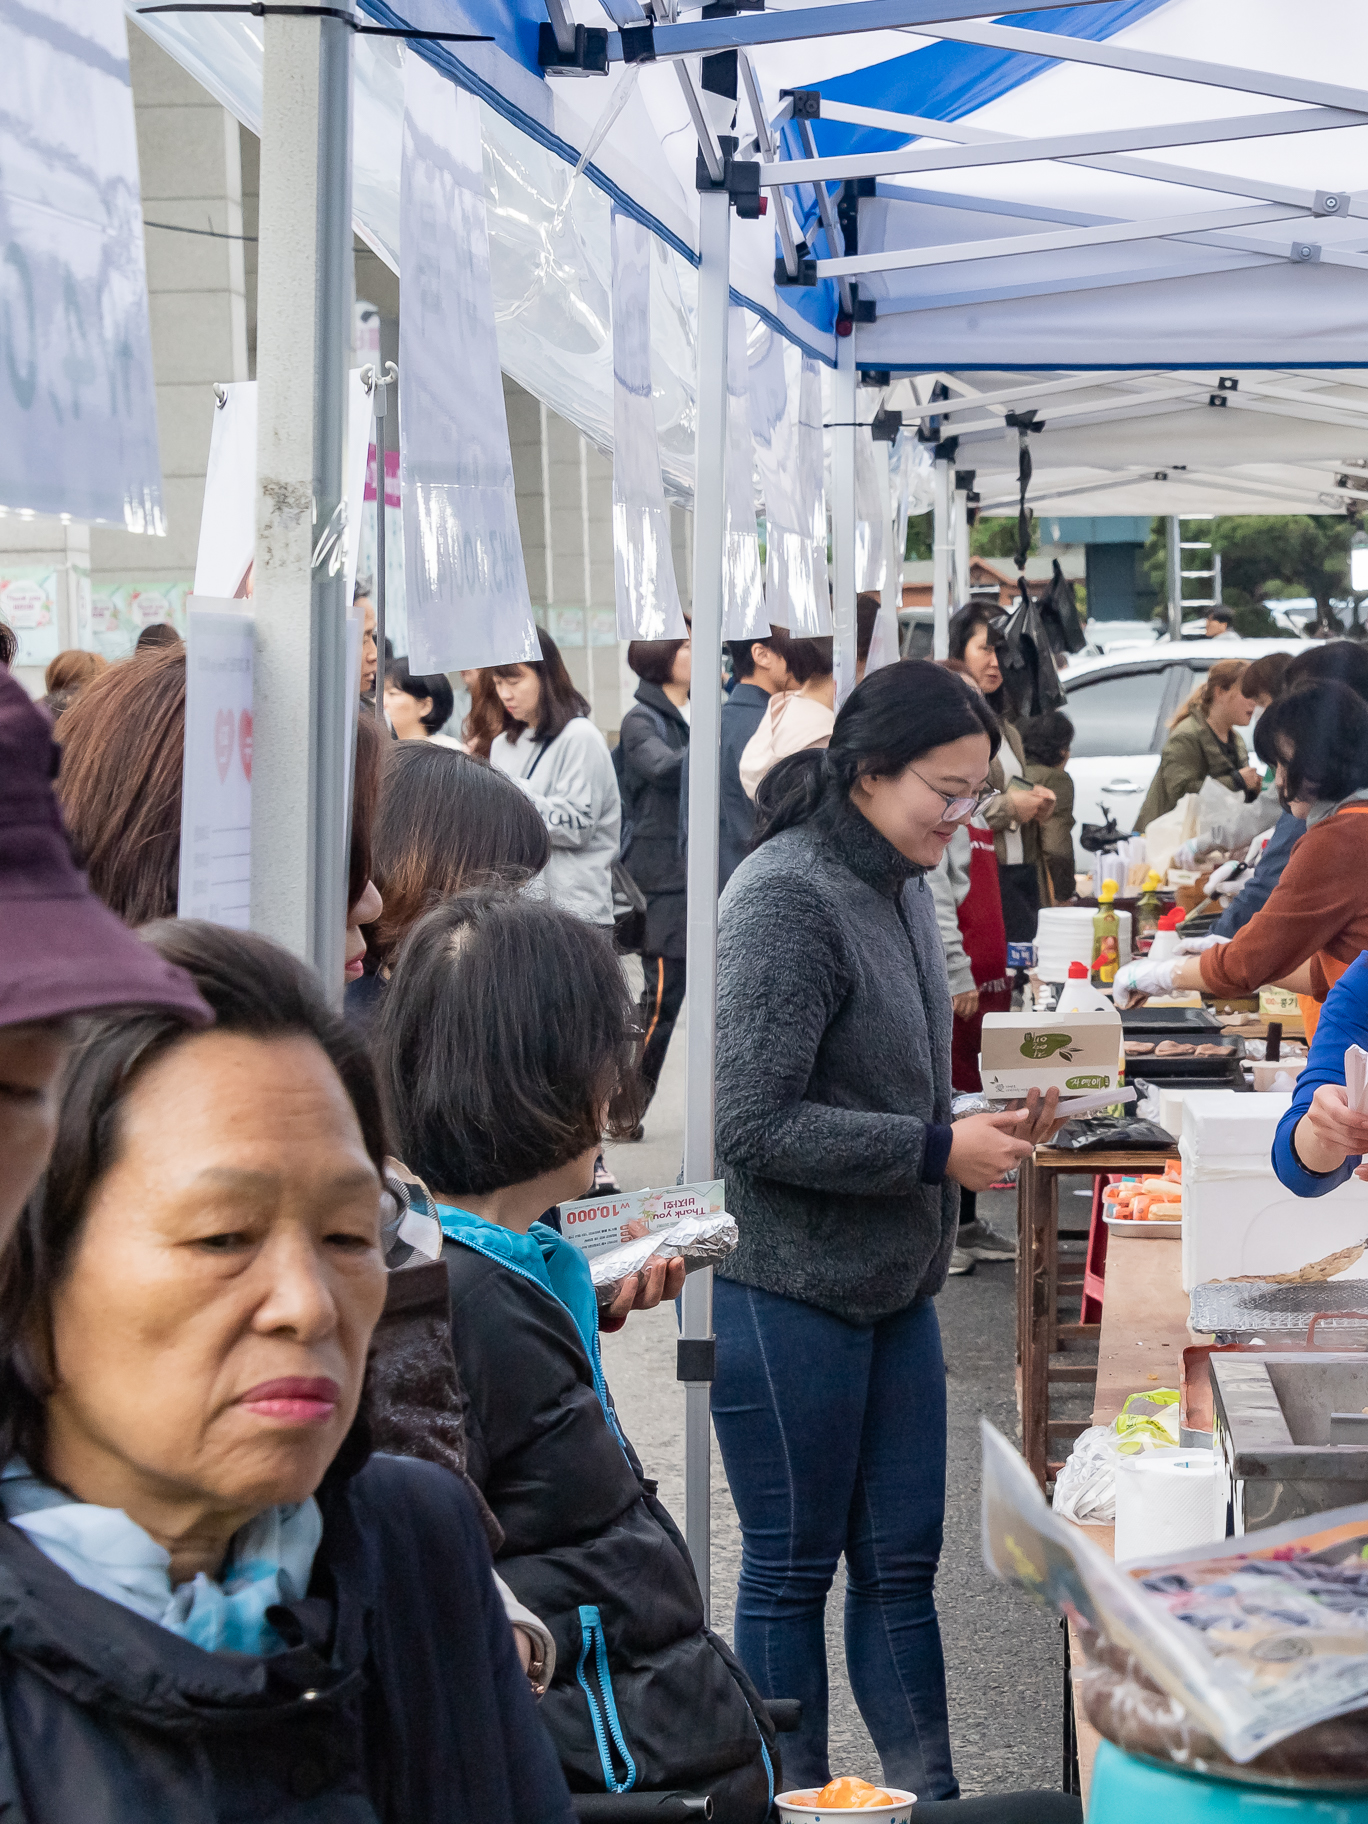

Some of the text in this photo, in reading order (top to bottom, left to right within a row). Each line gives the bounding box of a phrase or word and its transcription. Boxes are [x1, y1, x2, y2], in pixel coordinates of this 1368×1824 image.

[663, 1197, 695, 1210] 바자회
[652, 1206, 706, 1220] Thank you
